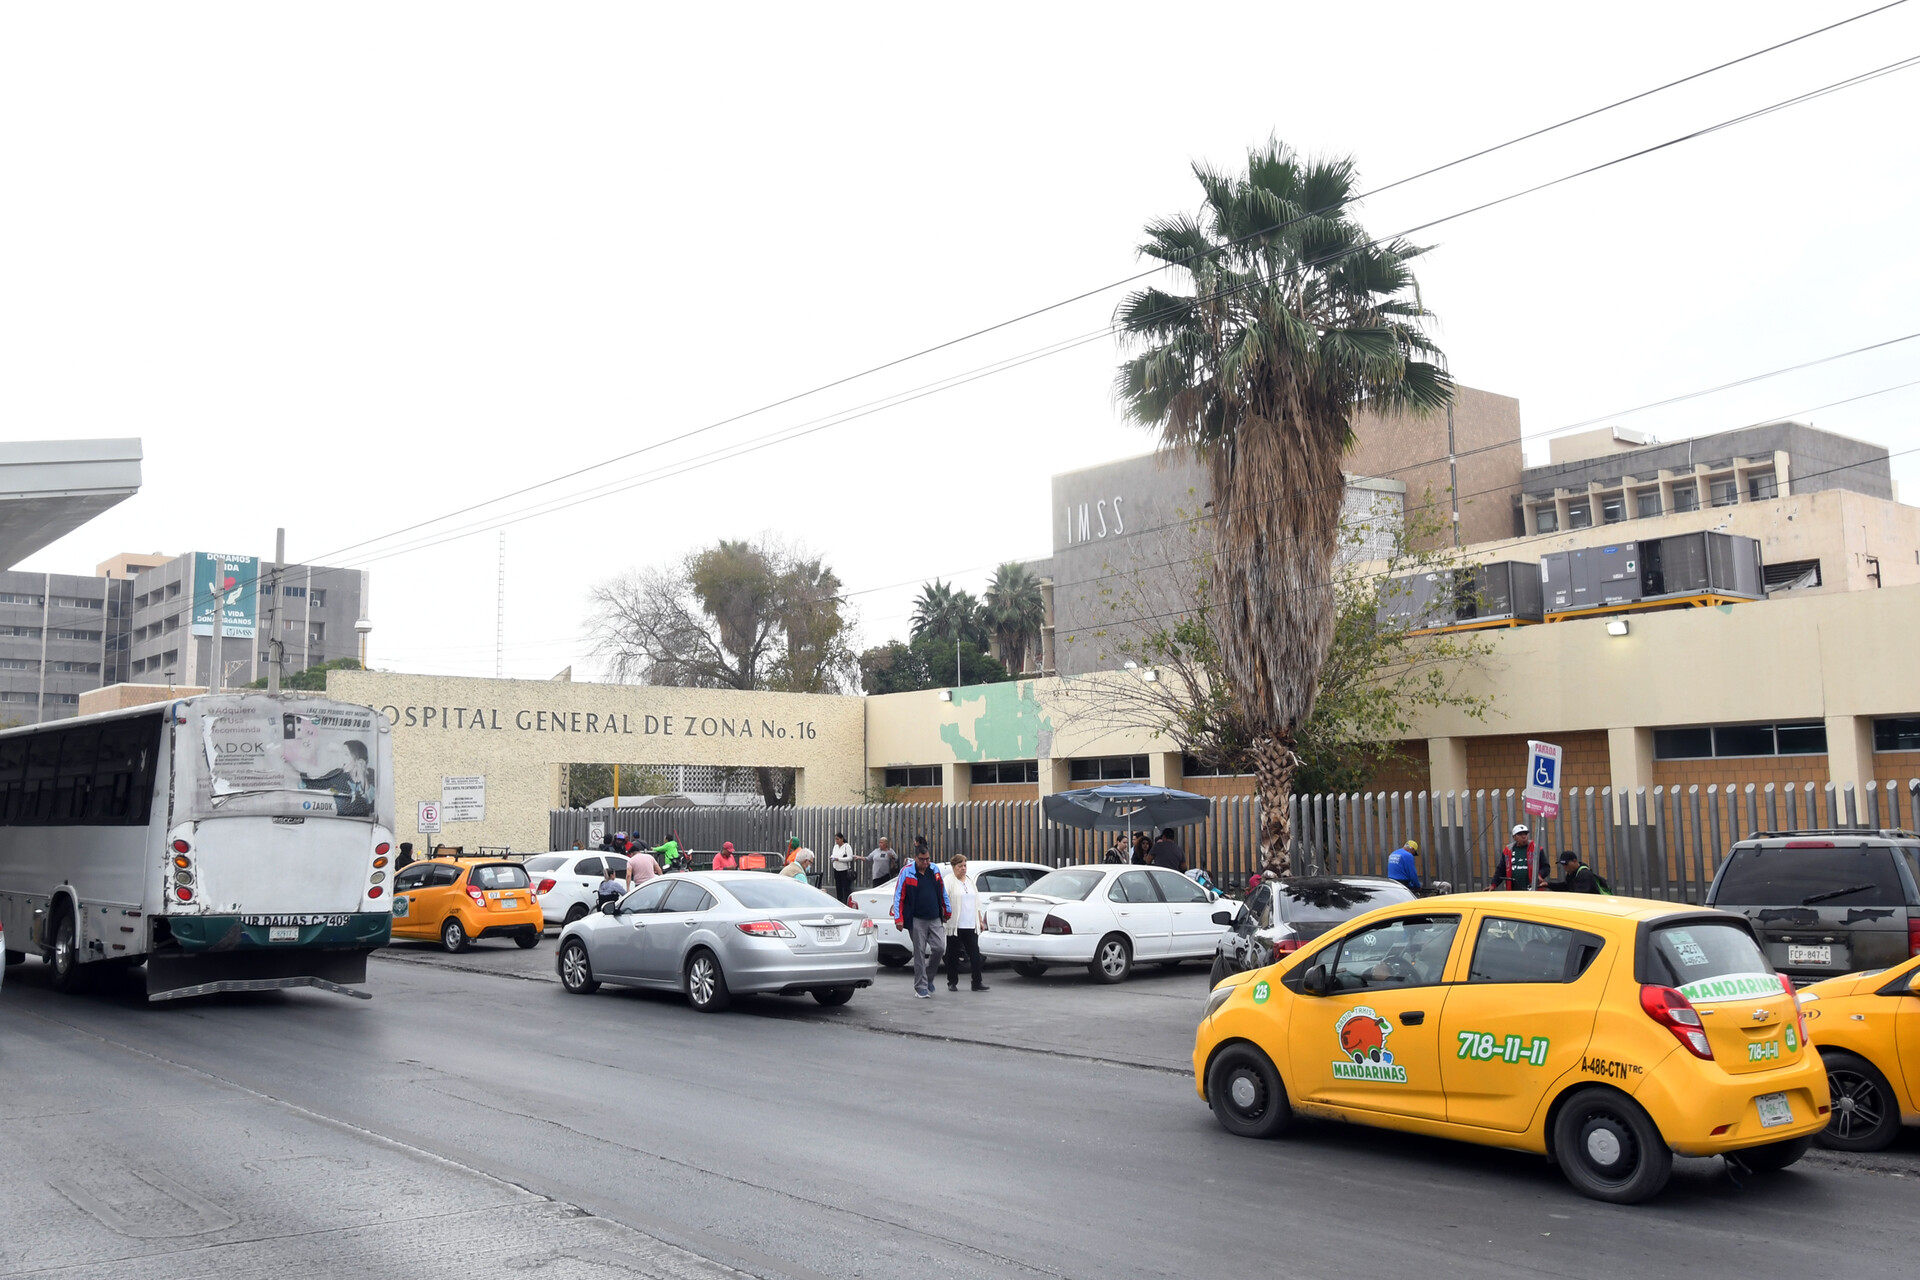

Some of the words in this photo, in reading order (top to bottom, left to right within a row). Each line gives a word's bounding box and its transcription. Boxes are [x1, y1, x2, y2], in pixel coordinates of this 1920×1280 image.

[1067, 496, 1124, 544] IMSS
[206, 553, 251, 564] DONAMOS
[223, 564, 240, 572] IDA
[222, 617, 252, 625] RGANOS
[215, 705, 256, 715] Adquiere
[370, 704, 503, 730] OSPITAL
[515, 709, 633, 734] GENERAL
[644, 714, 673, 735] DE
[684, 716, 753, 738] ZONA
[1534, 743, 1557, 756] PARADA
[1541, 790, 1556, 801] ROSA
[240, 915, 260, 926] UR
[264, 915, 307, 927] DALIAS
[1790, 950, 1830, 960] FCP-847-C
[1254, 984, 1268, 999] 225
[1680, 977, 1785, 999] MANDARINAS
[1458, 1032, 1548, 1065] 718-11-11
[1748, 1041, 1779, 1061] 718-11-11
[1333, 1062, 1406, 1082] MANDARINAS
[1580, 1056, 1628, 1080] A-486-CTN
[1628, 1063, 1644, 1075] TRC
